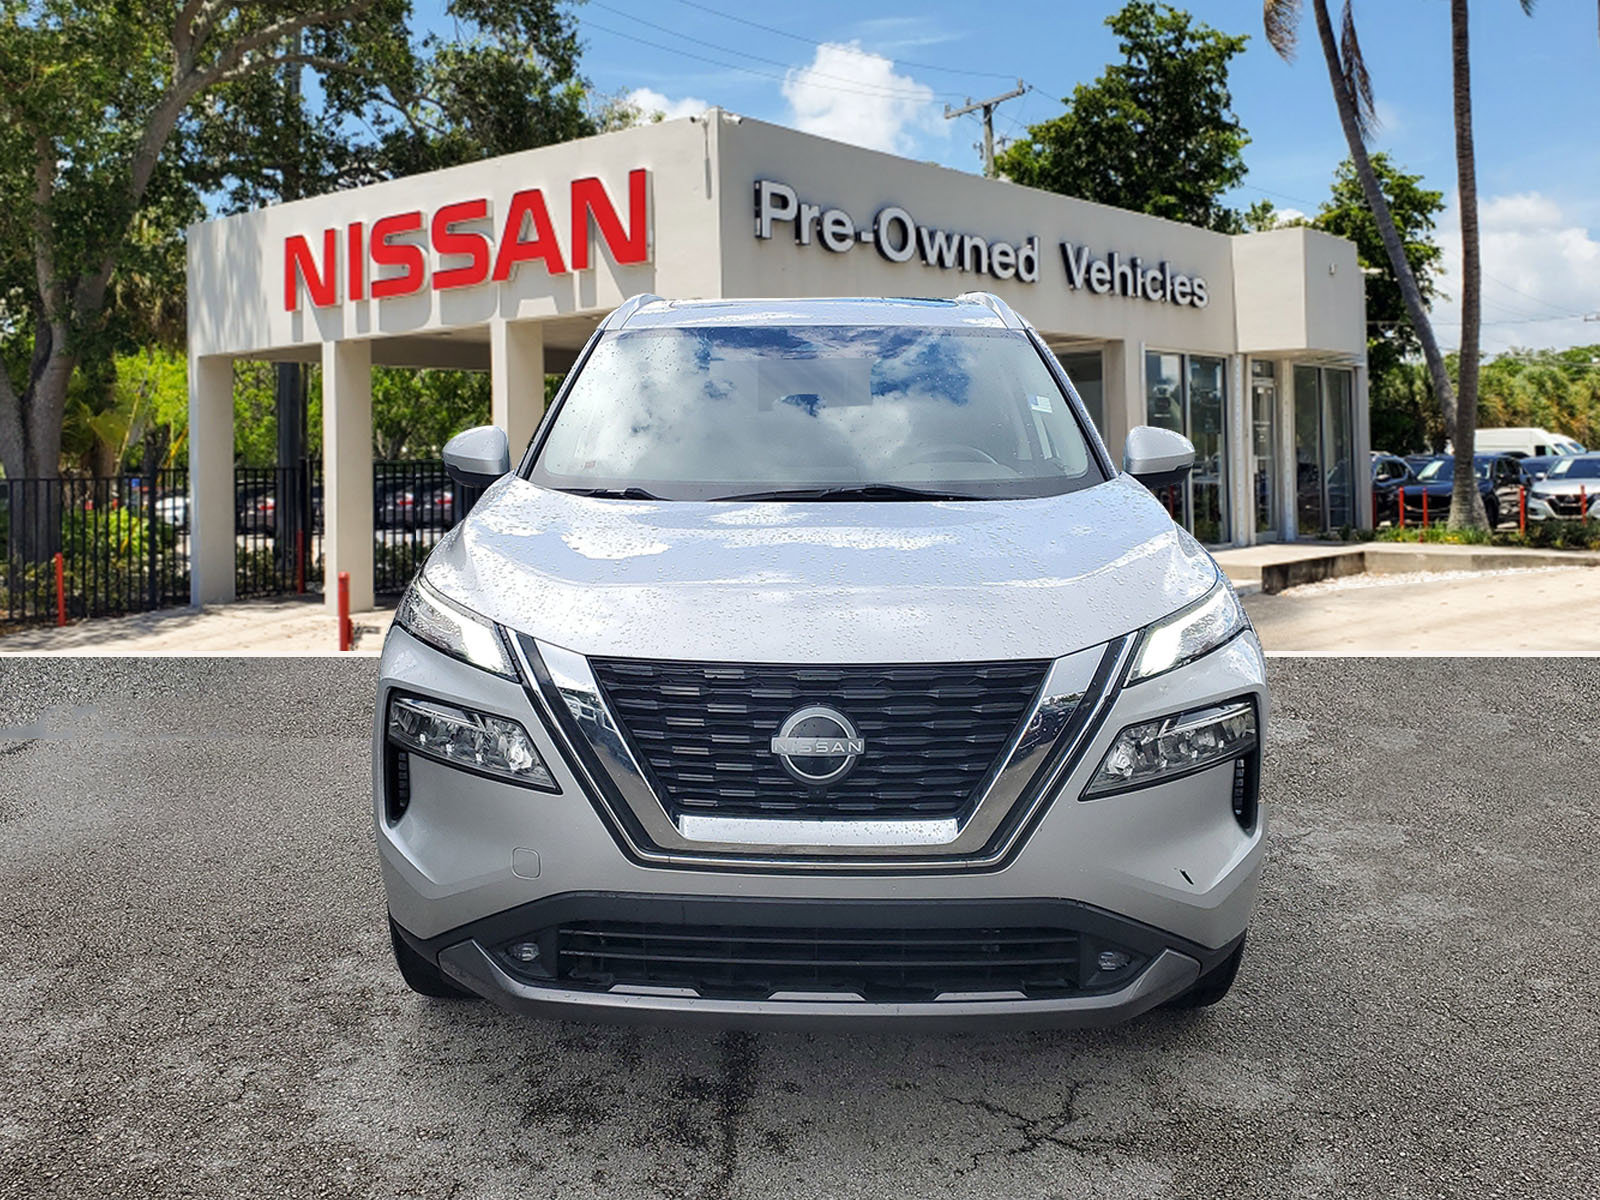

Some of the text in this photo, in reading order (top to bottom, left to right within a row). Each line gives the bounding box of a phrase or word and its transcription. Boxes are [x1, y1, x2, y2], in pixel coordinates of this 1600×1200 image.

[284, 167, 649, 312] NISSAN
[754, 179, 1210, 309] Pre-Owned Vehicles
[774, 741, 862, 753] NISSAN
